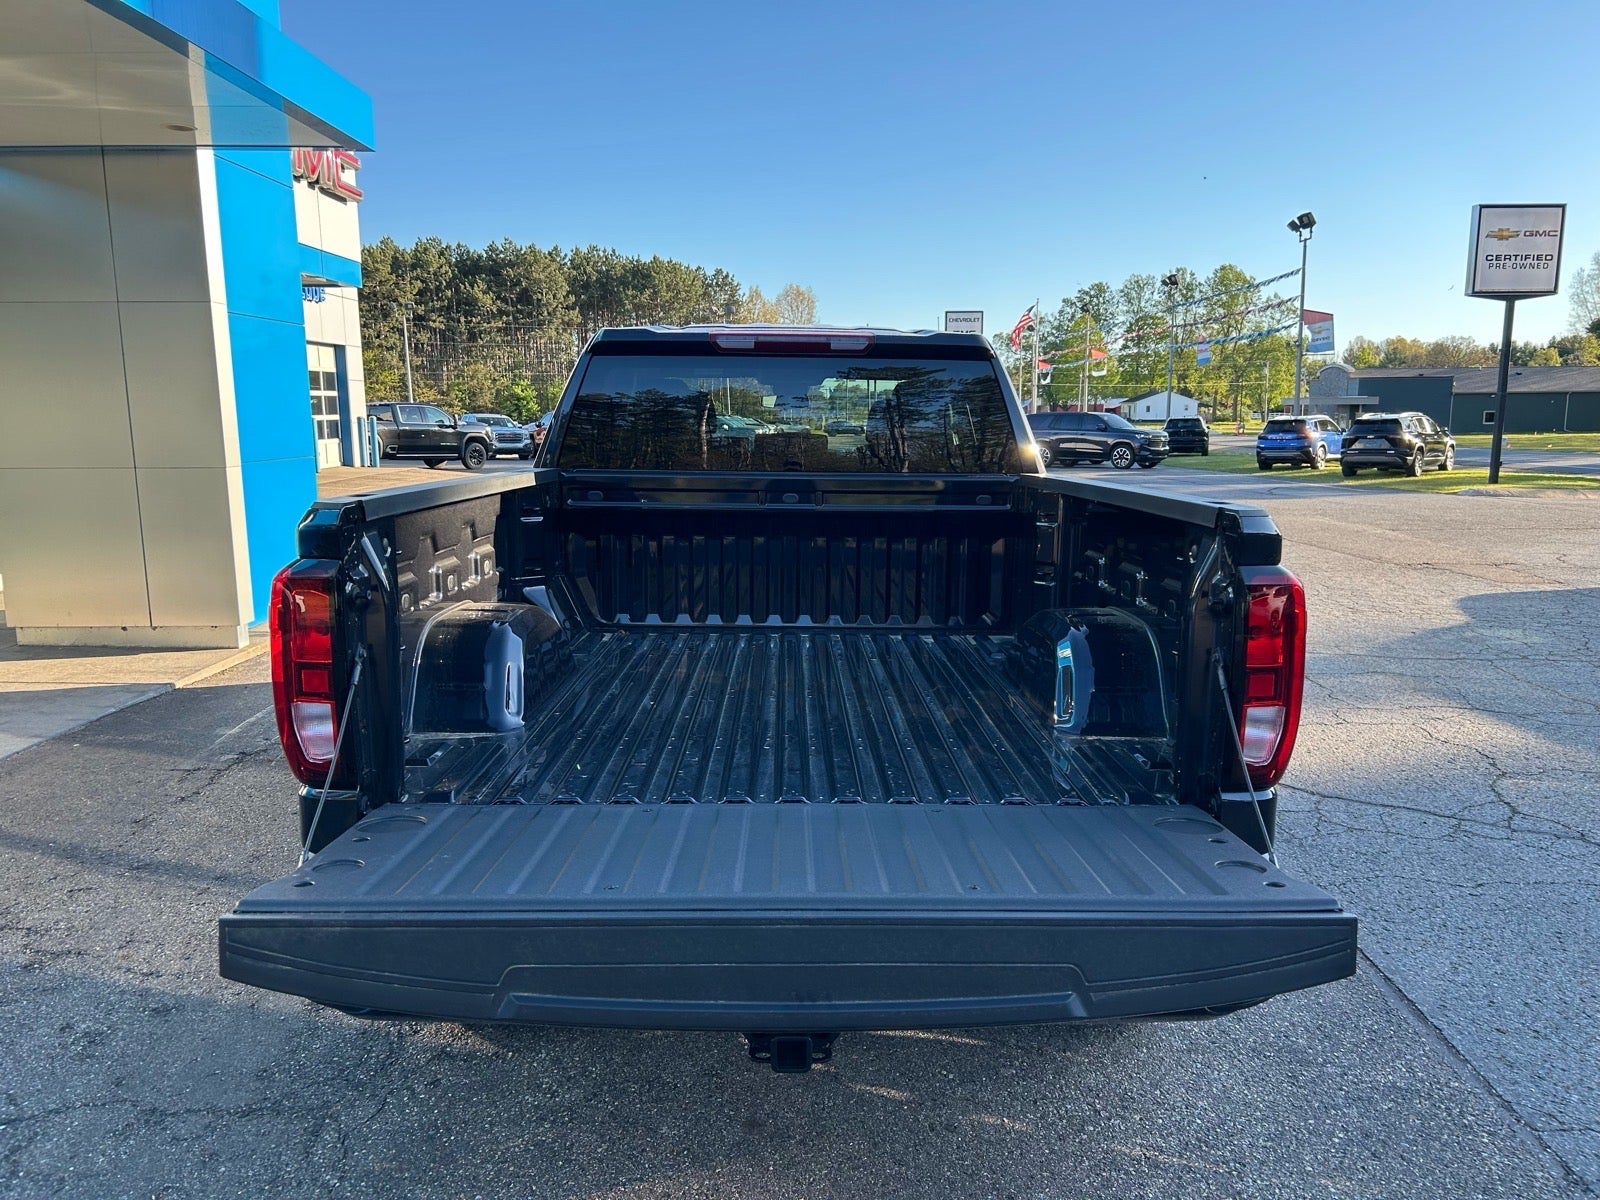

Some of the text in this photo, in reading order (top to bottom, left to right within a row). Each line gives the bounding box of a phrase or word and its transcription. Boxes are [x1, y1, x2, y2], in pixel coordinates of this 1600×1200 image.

[294, 148, 364, 202] MC
[1485, 254, 1553, 262] CERTIFIED
[1488, 262, 1549, 270] PRE-OWNED
